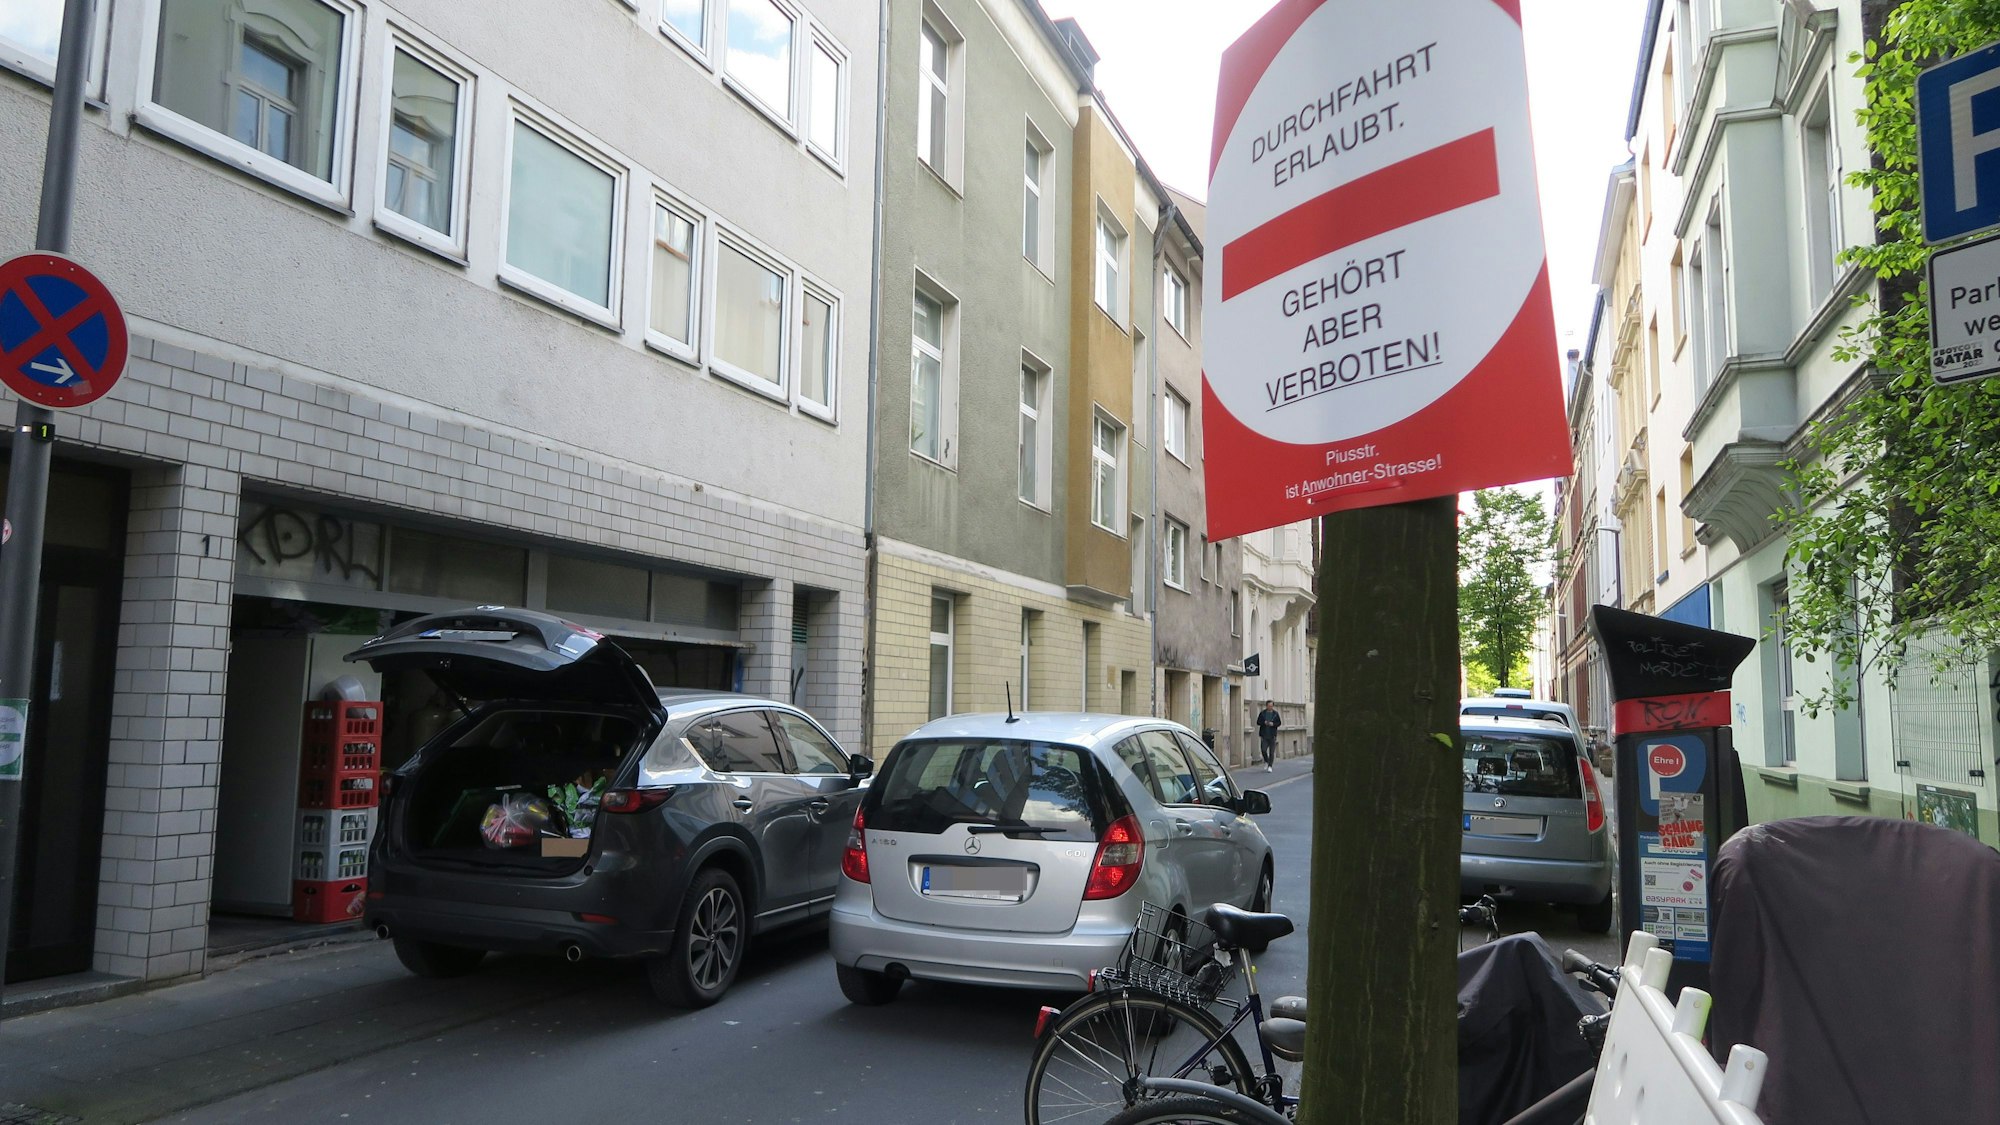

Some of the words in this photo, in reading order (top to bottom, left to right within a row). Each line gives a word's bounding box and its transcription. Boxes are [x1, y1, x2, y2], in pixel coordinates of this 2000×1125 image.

[1251, 41, 1438, 164] DURCHFAHRT
[1273, 102, 1405, 188] ERLAUBT.
[1282, 249, 1406, 318] GEHÖRT
[1951, 276, 2000, 309] Par
[1302, 302, 1383, 353] ABER
[1265, 331, 1441, 408] VERBOTEN!
[1933, 348, 1984, 369] QATAR
[41, 425, 48, 438] 1
[1326, 444, 1380, 466] Piusstr.
[1285, 483, 1299, 499] ist
[1301, 453, 1443, 496] Anwohner-Strasse!
[202, 534, 211, 558] 1
[1653, 756, 1674, 765] Ehre
[1065, 849, 1087, 857] CDI
